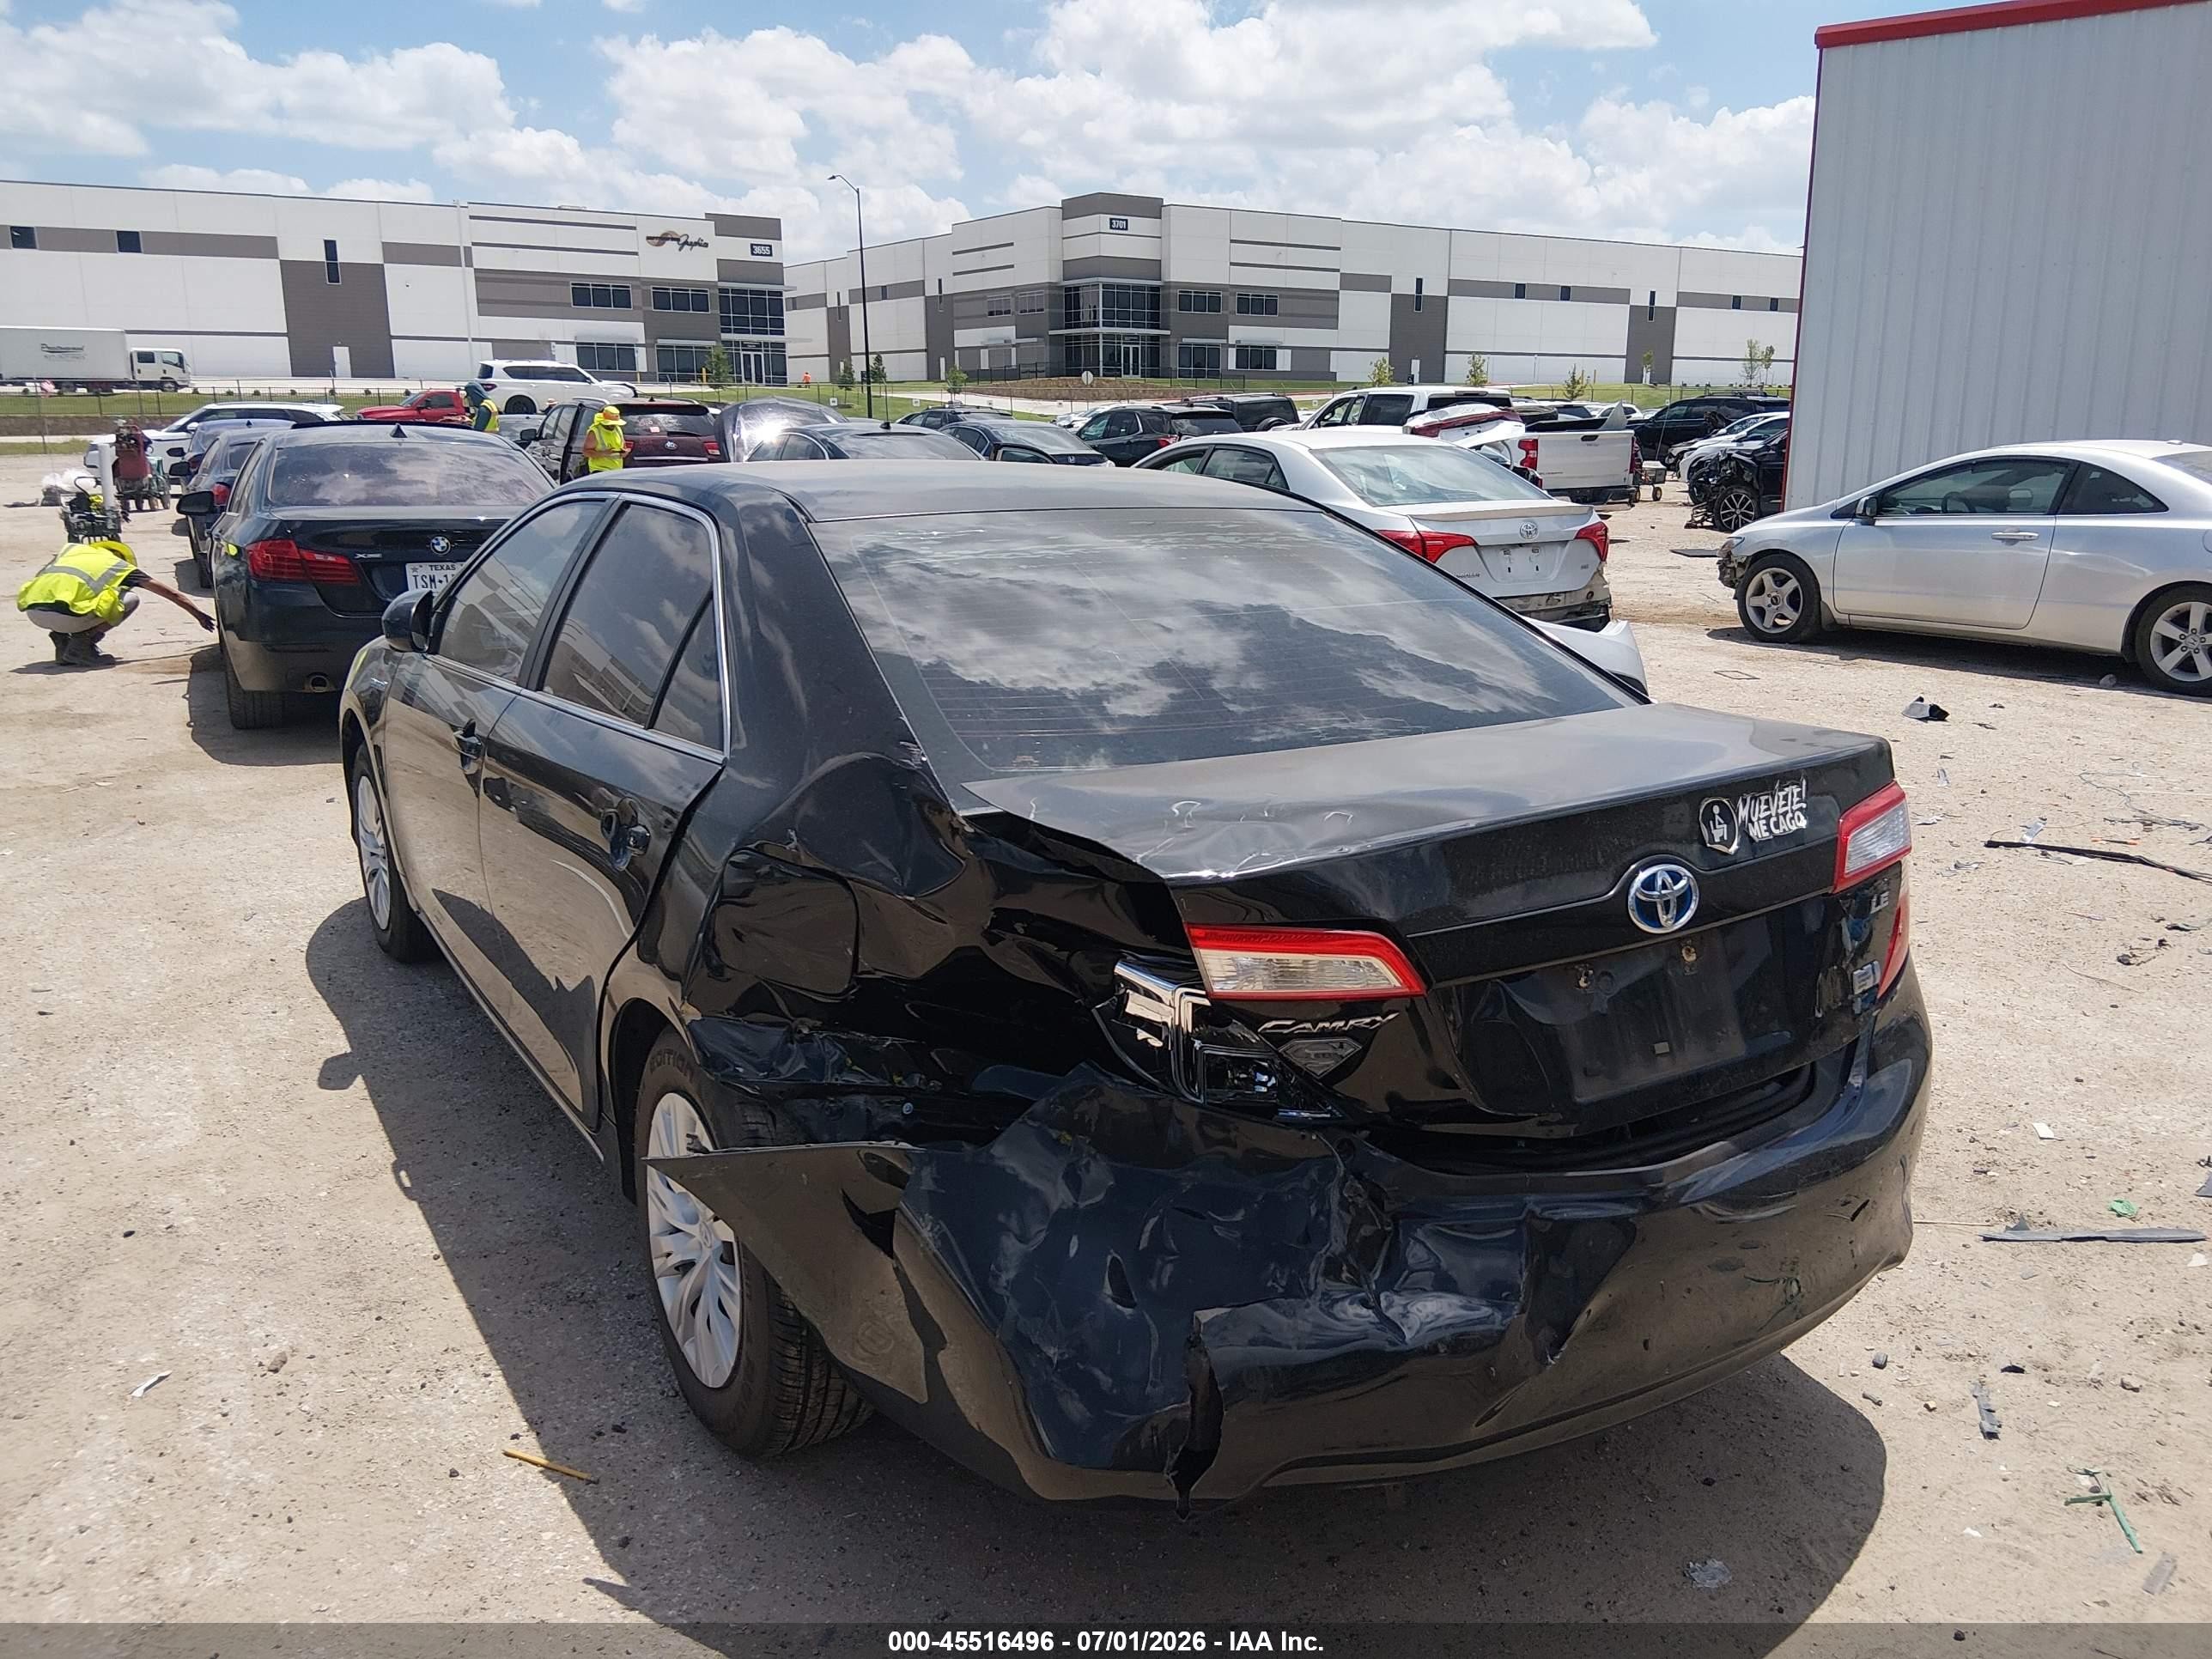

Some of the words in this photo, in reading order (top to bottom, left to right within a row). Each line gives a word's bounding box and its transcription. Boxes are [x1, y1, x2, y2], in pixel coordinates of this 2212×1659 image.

[1111, 220, 1127, 229] 3701
[752, 246, 770, 254] 3655
[1748, 818, 1770, 839] ME
[1769, 811, 1808, 834] CAGO
[1870, 890, 1889, 915] LE
[1257, 1012, 1400, 1034] CAMRY
